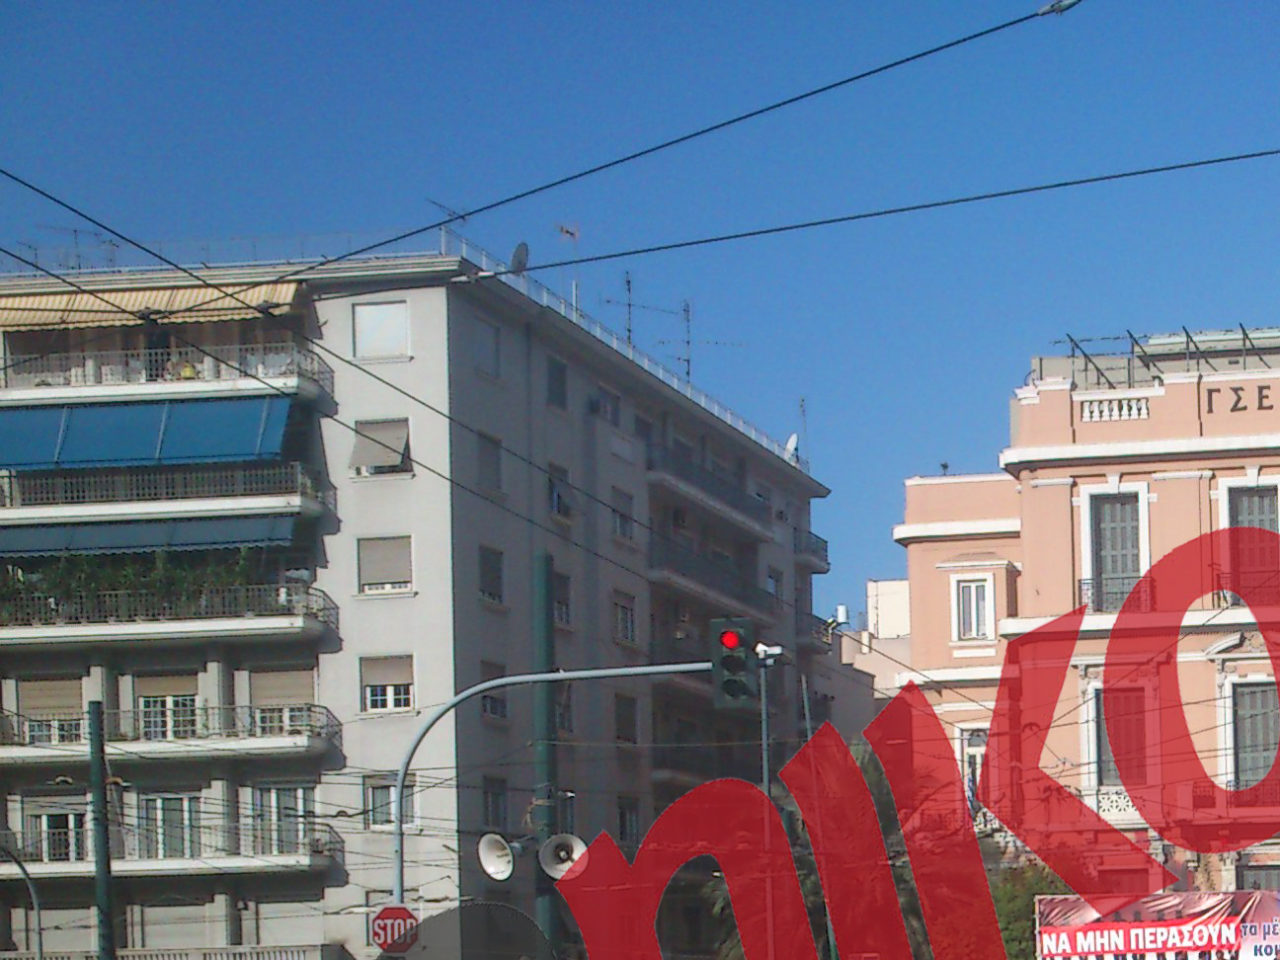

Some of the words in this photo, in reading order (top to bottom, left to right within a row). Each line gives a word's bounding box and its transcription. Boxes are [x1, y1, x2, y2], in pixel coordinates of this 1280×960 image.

[373, 918, 418, 944] STOP
[1042, 931, 1072, 955] ΝΑ
[1076, 929, 1124, 953] ΜΗΝ
[1130, 923, 1236, 950] ΠΕΡΑΣΟΥΝ
[1241, 923, 1258, 937] τα
